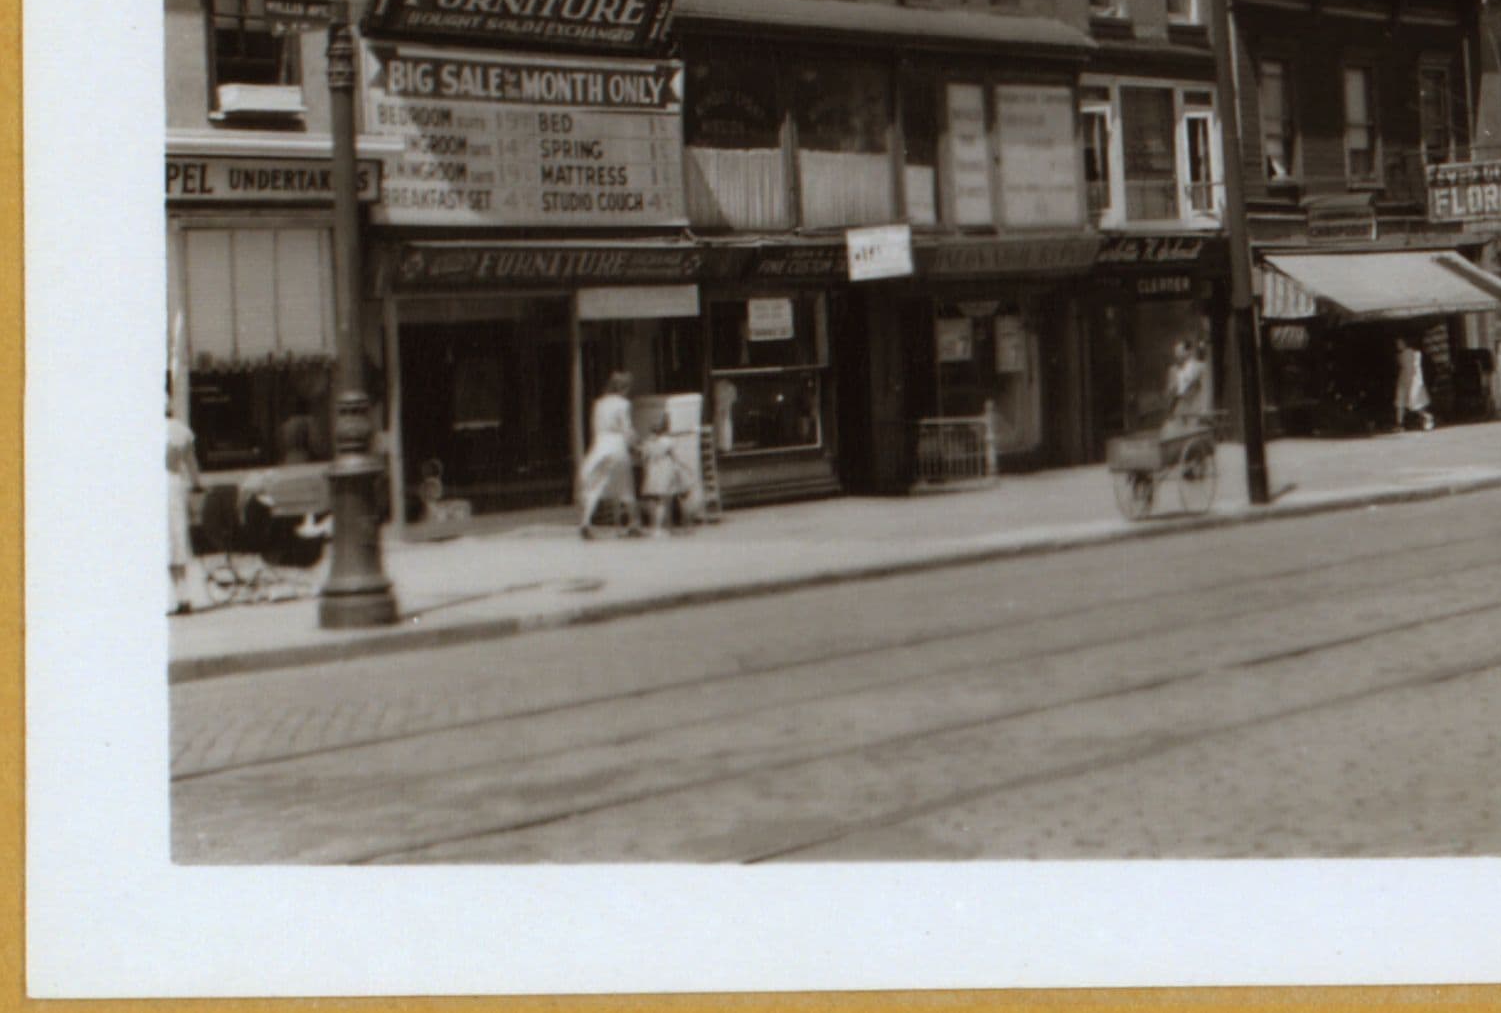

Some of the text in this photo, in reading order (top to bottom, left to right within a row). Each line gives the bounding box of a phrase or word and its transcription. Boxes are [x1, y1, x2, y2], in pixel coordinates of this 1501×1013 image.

[388, 62, 433, 92] BIG
[440, 64, 503, 97] SALE
[519, 70, 604, 103] MONTH
[607, 75, 665, 104] ONLY
[537, 111, 573, 134] BED
[538, 138, 604, 161] SPRING
[166, 163, 370, 193] PEL UNDERTAKS
[539, 165, 629, 187] MATTRESS
[541, 191, 593, 213] STUDIO
[596, 192, 644, 213] COUCH
[475, 249, 626, 277] FURNITURE
